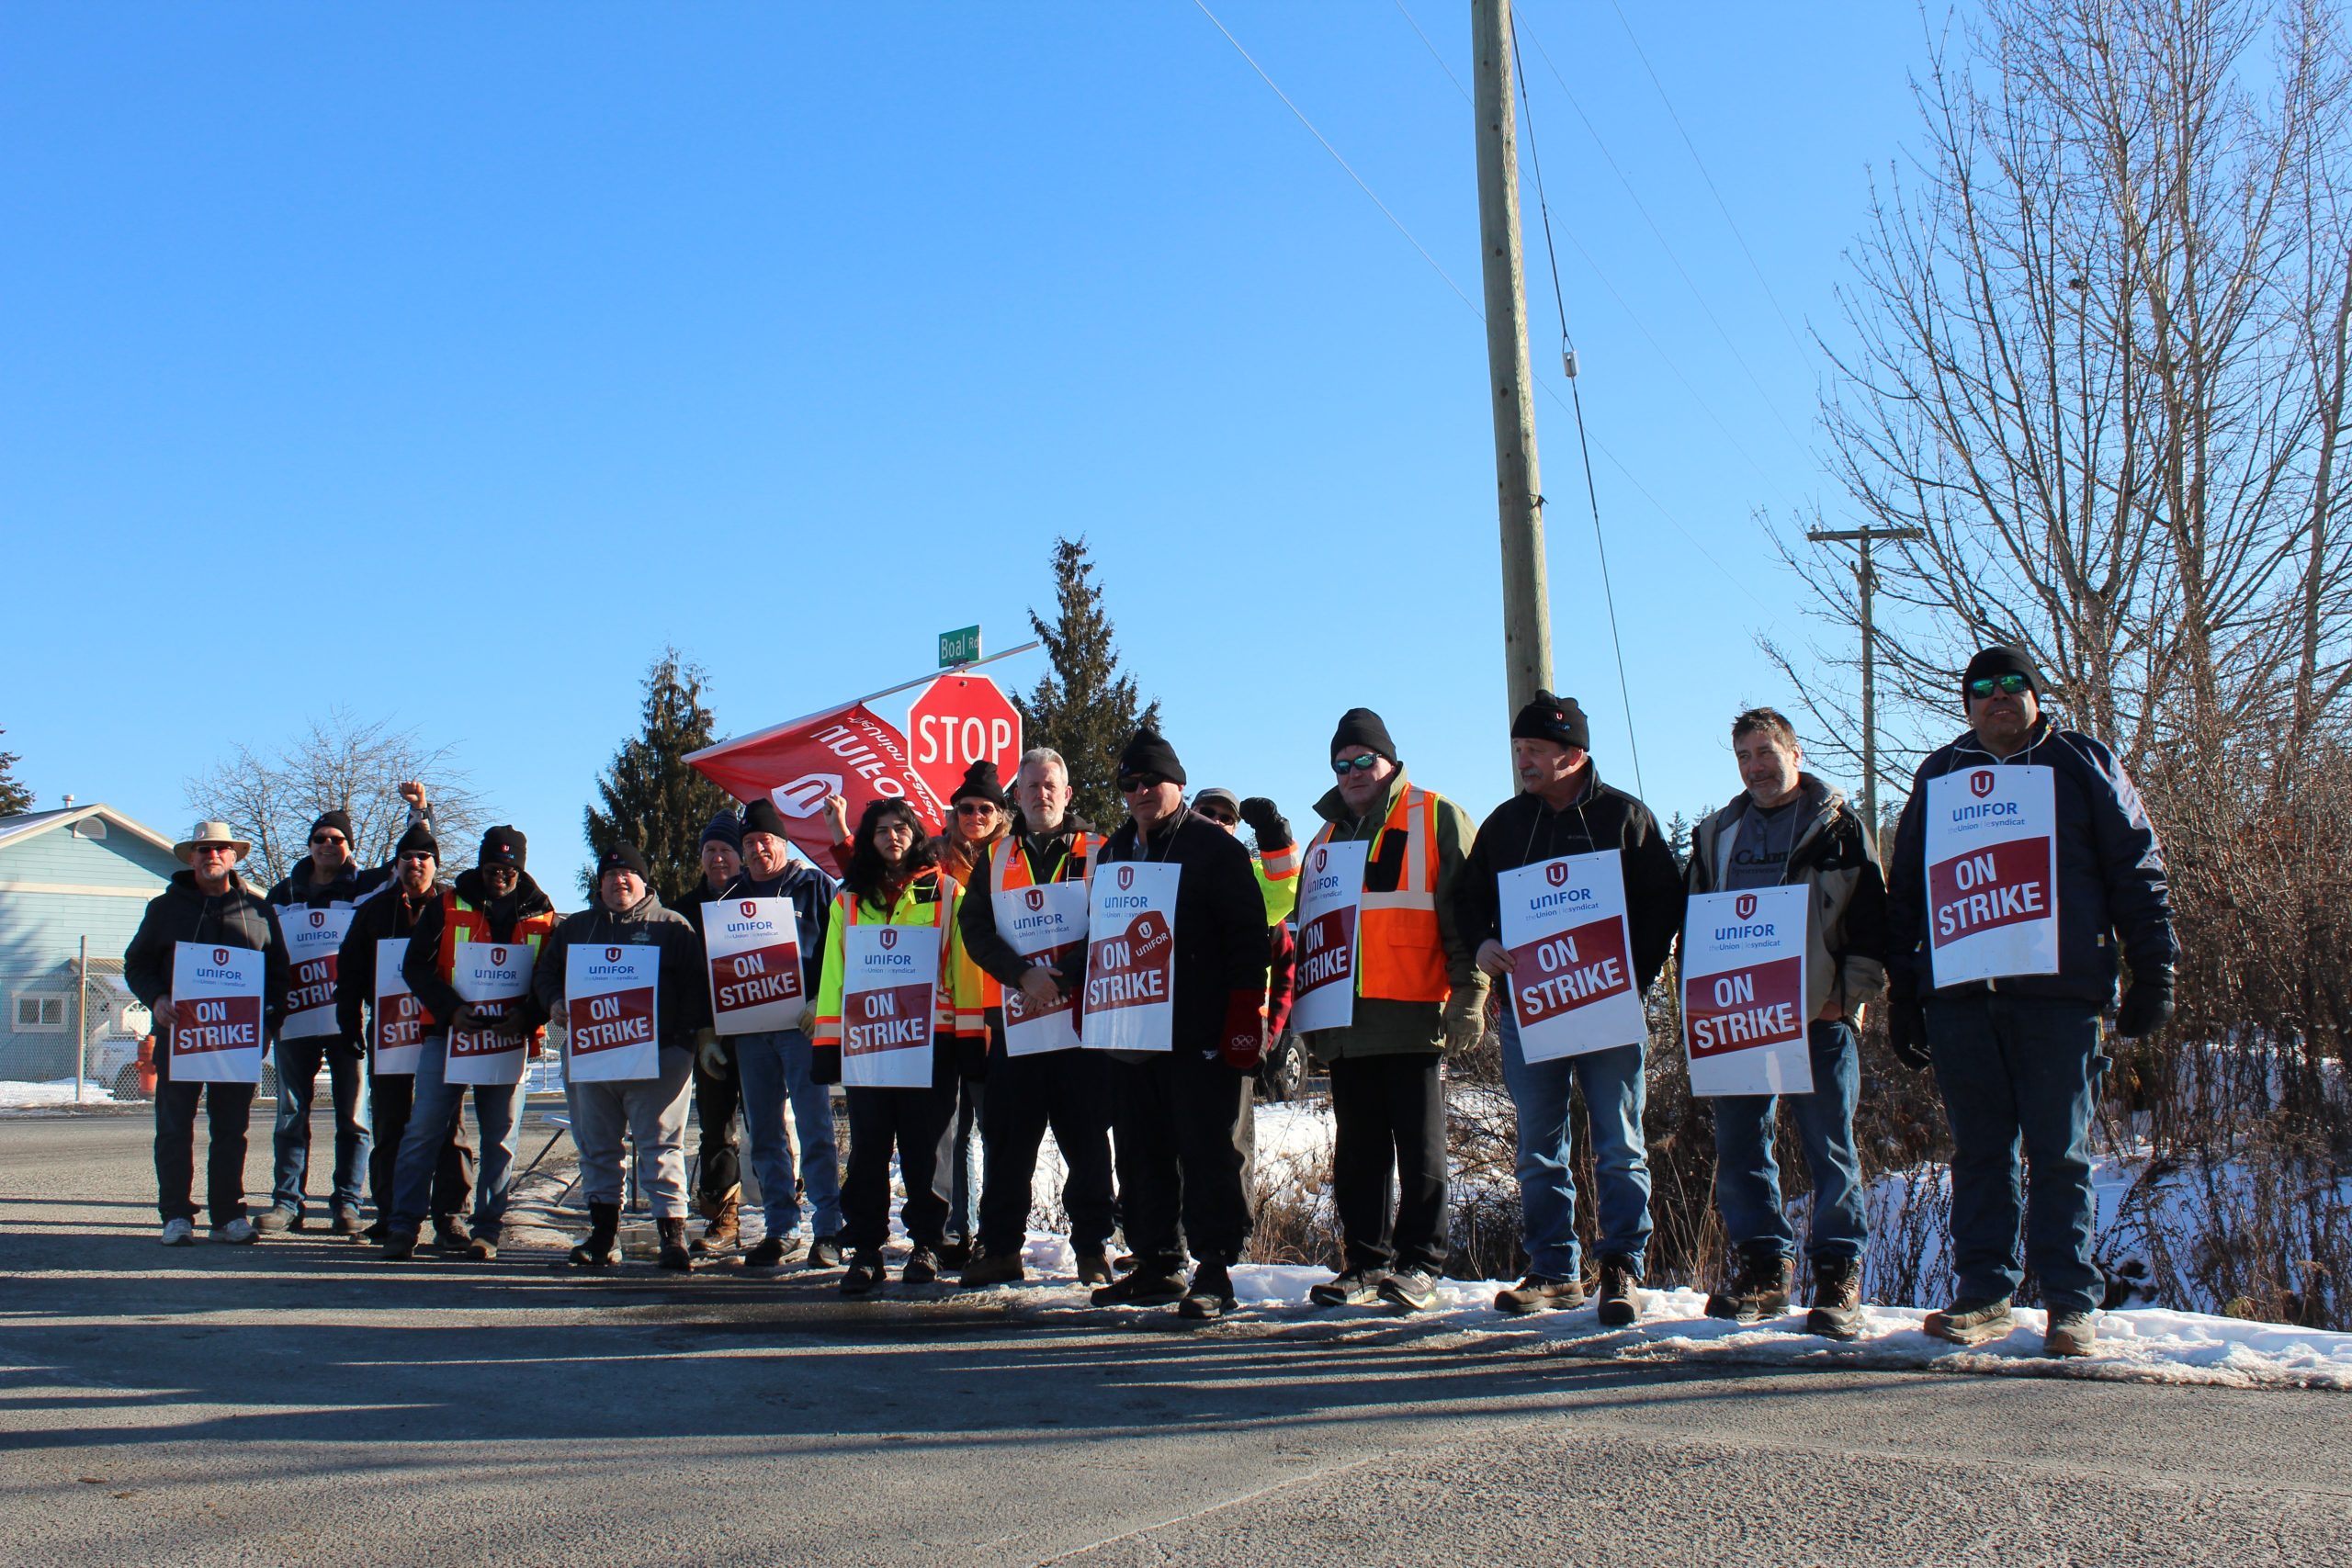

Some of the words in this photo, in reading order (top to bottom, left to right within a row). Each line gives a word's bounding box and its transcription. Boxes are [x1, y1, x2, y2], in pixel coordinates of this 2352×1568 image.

[941, 633, 966, 660] Boal
[968, 636, 978, 649] Rd
[919, 715, 1011, 765] STOP
[1955, 852, 1997, 890] ON
[1939, 881, 2044, 936] STRIKE
[1306, 921, 1324, 954] ON
[1536, 935, 1579, 973] ON
[734, 953, 764, 978] ON
[1102, 940, 1131, 970] ON
[1296, 945, 1348, 993] STRIKE
[300, 961, 328, 983] ON
[1090, 969, 1164, 1006] STRIKE
[1521, 956, 1624, 1015] STRIKE
[719, 972, 797, 1007] STRIKE
[865, 992, 895, 1019] ON
[1714, 974, 1755, 1008] ON
[196, 1002, 226, 1022] ON
[590, 997, 620, 1021] ON
[1694, 1001, 1795, 1050] STRIKE
[178, 1023, 255, 1049] STRIKE
[576, 1017, 650, 1049] STRIKE
[848, 1017, 924, 1050] STRIKE
